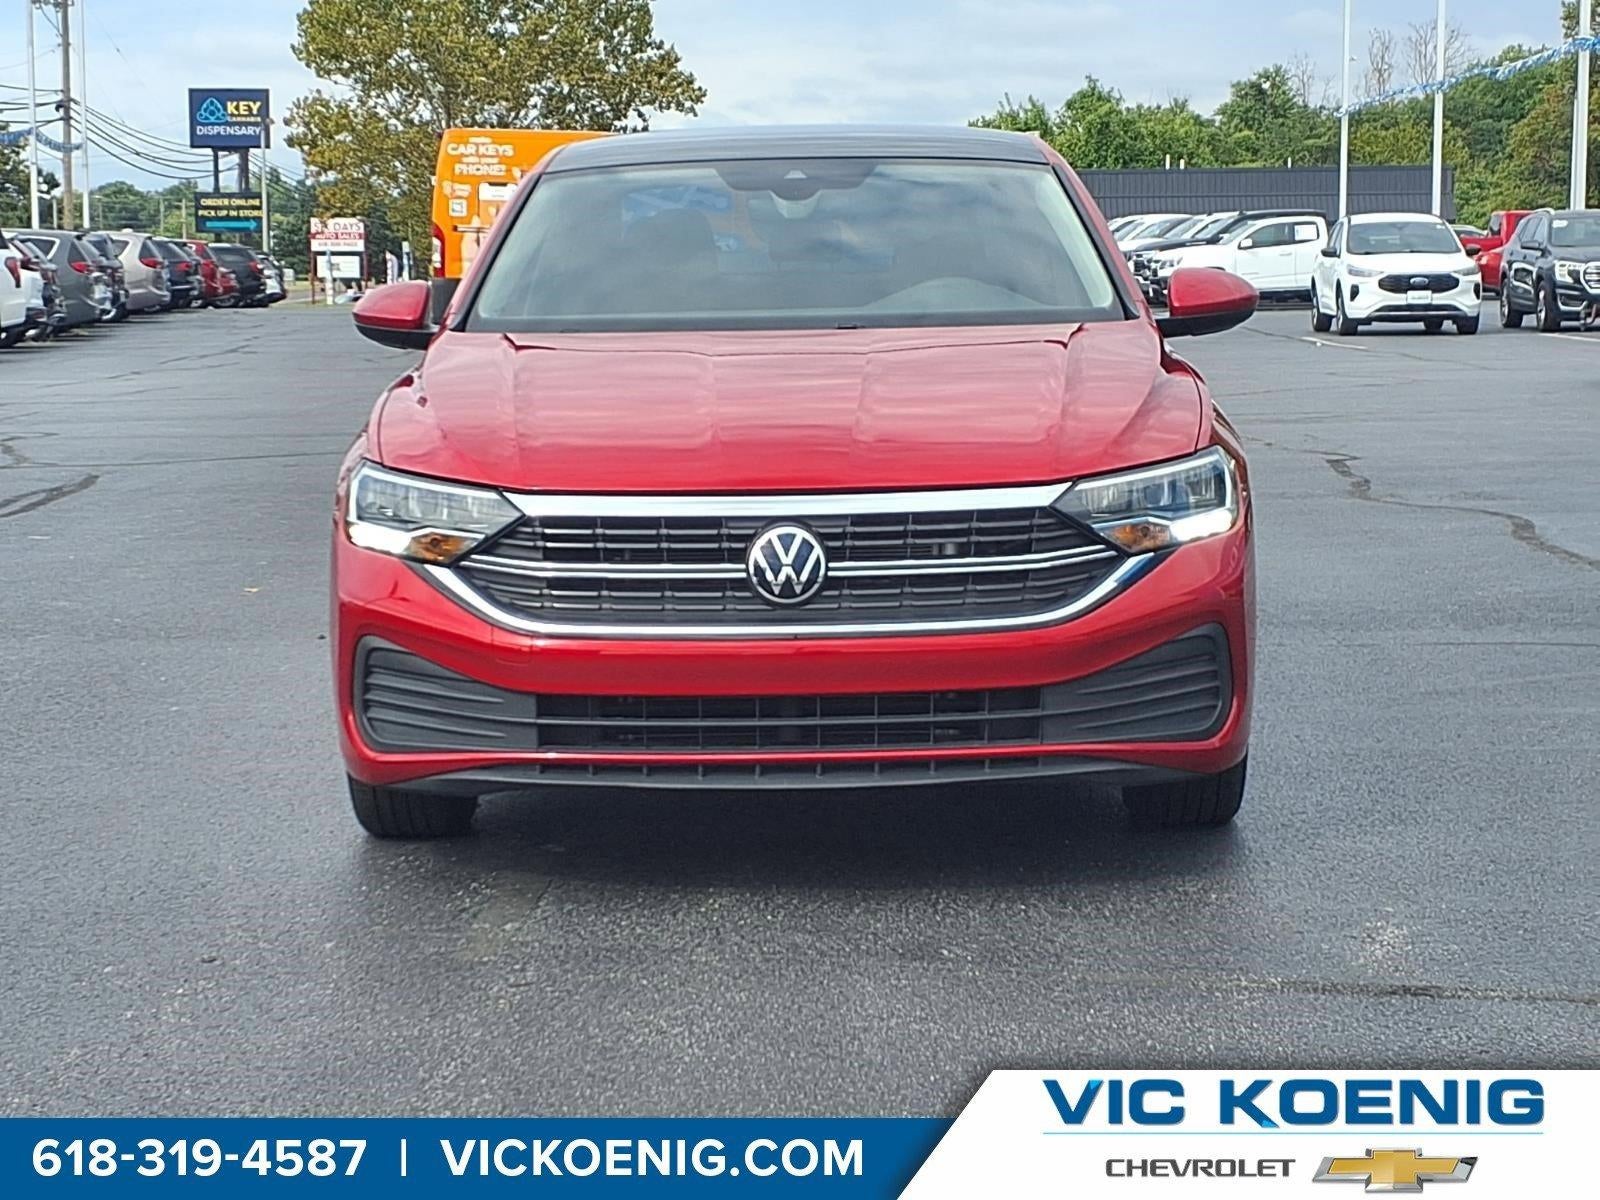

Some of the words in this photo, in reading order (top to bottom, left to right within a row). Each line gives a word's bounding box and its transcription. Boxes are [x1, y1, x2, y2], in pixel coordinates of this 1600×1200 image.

[226, 101, 261, 115] KEY
[196, 126, 261, 136] DISPENSARY
[447, 143, 477, 156] CAR
[478, 144, 514, 157] KEYS
[200, 198, 229, 206] ORDER
[230, 198, 260, 206] ONLINE
[198, 209, 216, 217] PICK
[216, 209, 228, 217] UP
[229, 209, 238, 217] IN
[333, 222, 361, 231] DAYS
